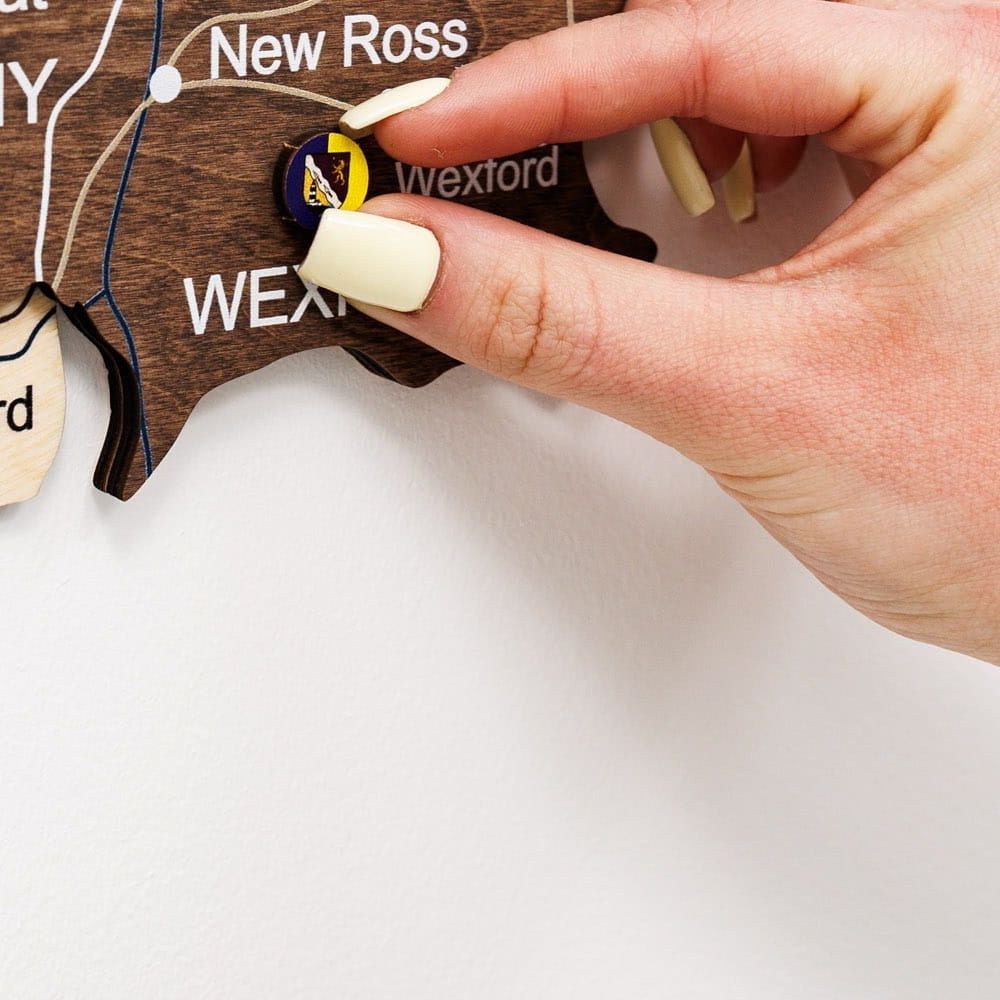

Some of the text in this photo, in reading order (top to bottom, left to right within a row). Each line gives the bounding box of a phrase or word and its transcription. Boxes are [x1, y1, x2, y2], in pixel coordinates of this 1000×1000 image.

[210, 14, 468, 80] New Ross
[183, 264, 347, 335] WEX
